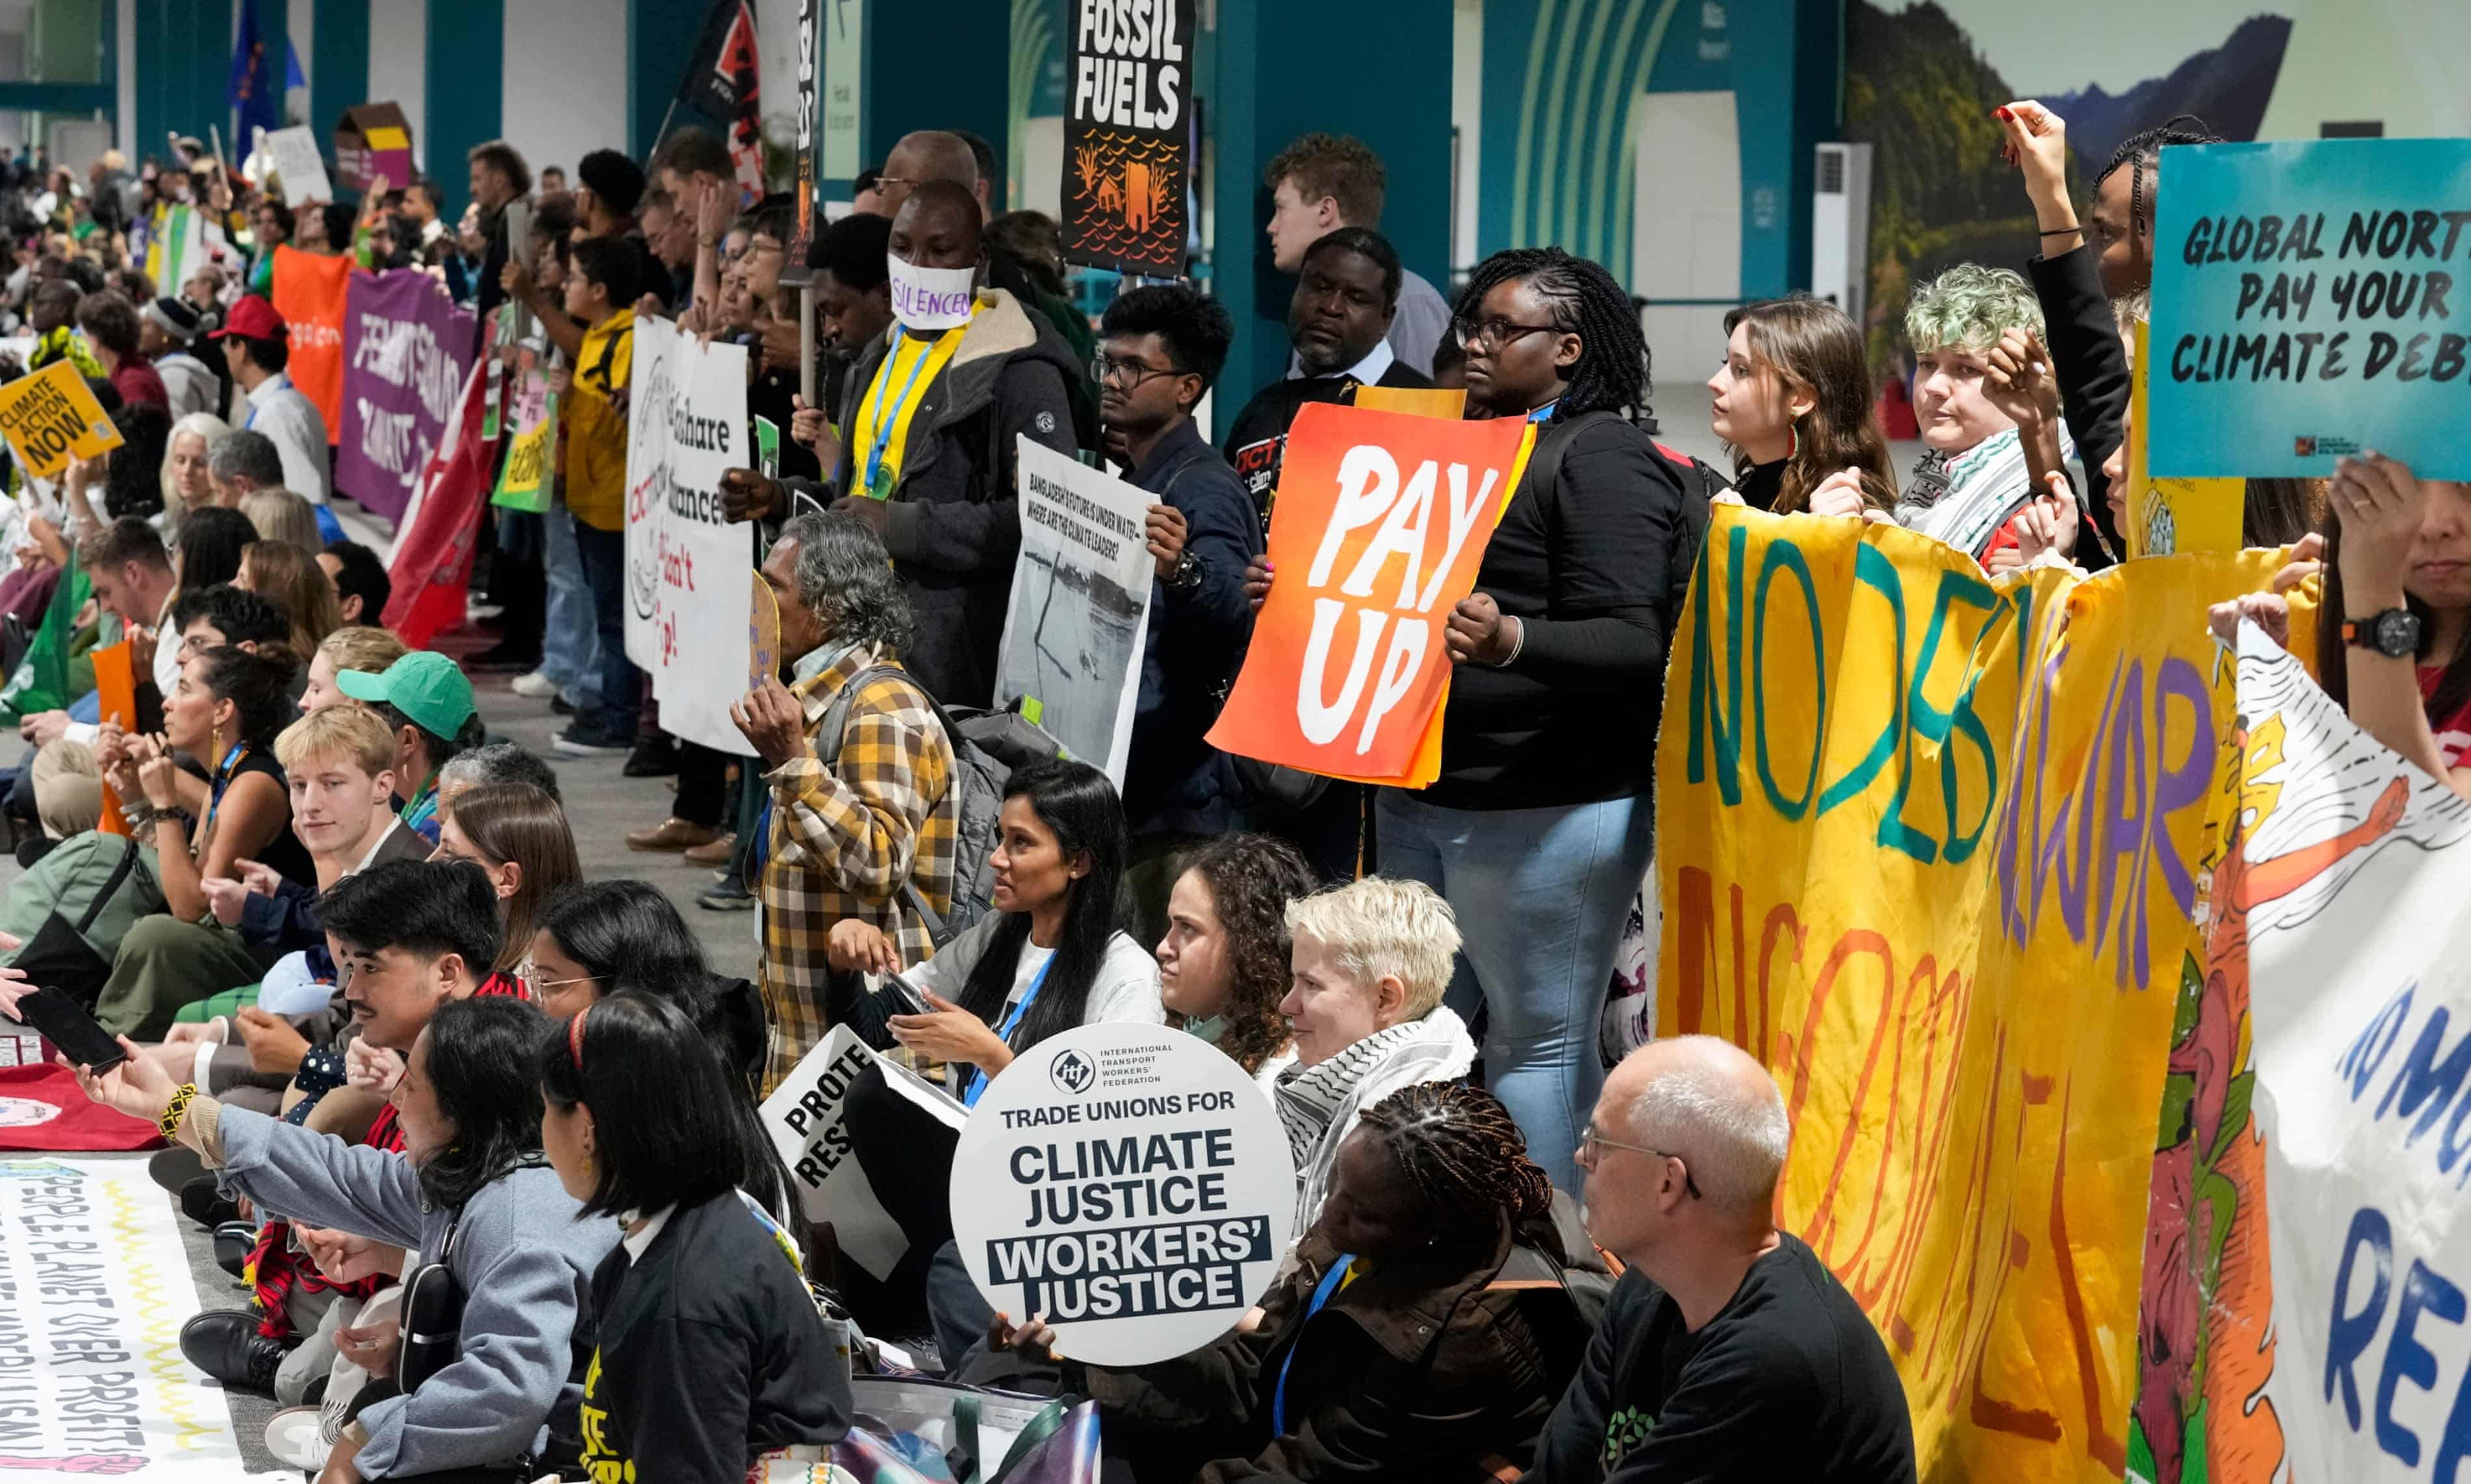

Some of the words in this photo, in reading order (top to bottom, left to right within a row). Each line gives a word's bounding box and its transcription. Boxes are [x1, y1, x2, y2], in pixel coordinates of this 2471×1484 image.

[1078, 0, 1182, 61] FOSSIL
[1075, 56, 1180, 130] FUELS
[2184, 213, 2325, 267] GLOBAL
[2338, 210, 2471, 261] NORT
[893, 277, 970, 317] SILENCED
[2236, 271, 2318, 321] PAY
[2331, 271, 2453, 322] YOUR
[2171, 332, 2350, 384] CLIMATE
[2362, 332, 2471, 385] DEB
[0, 376, 56, 430] CLIMATE
[20, 391, 70, 440] ACTION
[24, 406, 88, 470] NOW
[1027, 499, 1048, 525] WHERE
[1047, 510, 1059, 531] ARE
[1059, 514, 1068, 535] THE
[1068, 519, 1091, 549] CLIMATE
[1068, 492, 1090, 519] FUTURE
[1090, 501, 1096, 523] IS
[1096, 503, 1116, 531] UNDER
[1307, 445, 1500, 613] PAY
[1297, 597, 1429, 756] UP
[1686, 524, 1825, 823] NO
[1100, 1044, 1174, 1057] INTERNATIONAL
[1102, 1055, 1156, 1067] TRANSPORT
[1102, 1066, 1152, 1077] WORKERS'
[1103, 1076, 1161, 1087] FEDERATION
[1001, 1108, 1081, 1130] TRADE
[1087, 1095, 1182, 1122] UNIONS
[1187, 1091, 1236, 1113] FOR
[1009, 1128, 1235, 1185] CLIMATE
[1025, 1173, 1228, 1228] JUSTICE
[28, 1240, 115, 1308] PLANET
[995, 1219, 1262, 1280] WORKERS'
[1034, 1265, 1237, 1321] JUSTICE
[47, 1313, 132, 1366] OVER
[55, 1371, 146, 1451] PROFIT!
